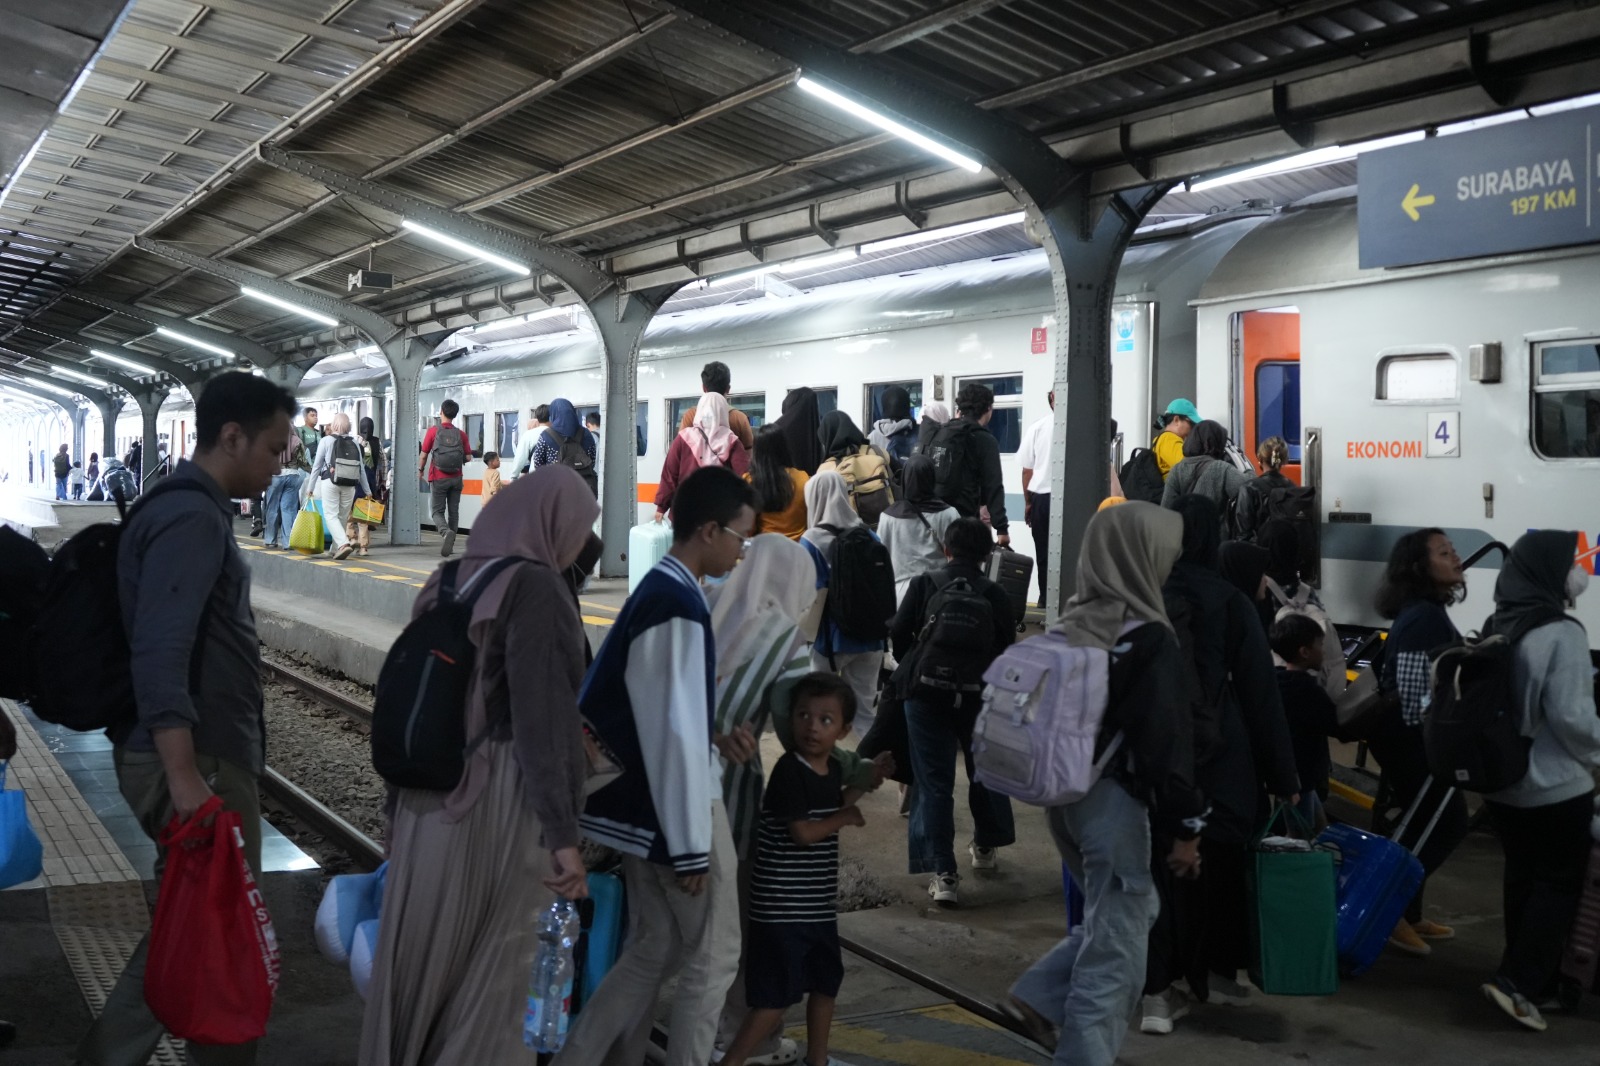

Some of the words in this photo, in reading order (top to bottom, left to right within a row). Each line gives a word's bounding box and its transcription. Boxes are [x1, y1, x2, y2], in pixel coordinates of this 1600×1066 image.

[1457, 159, 1575, 201] SURABAYA
[1510, 195, 1540, 215] 197
[1544, 187, 1577, 211] KM
[1435, 420, 1450, 444] 4
[1347, 440, 1422, 459] EKONOMI
